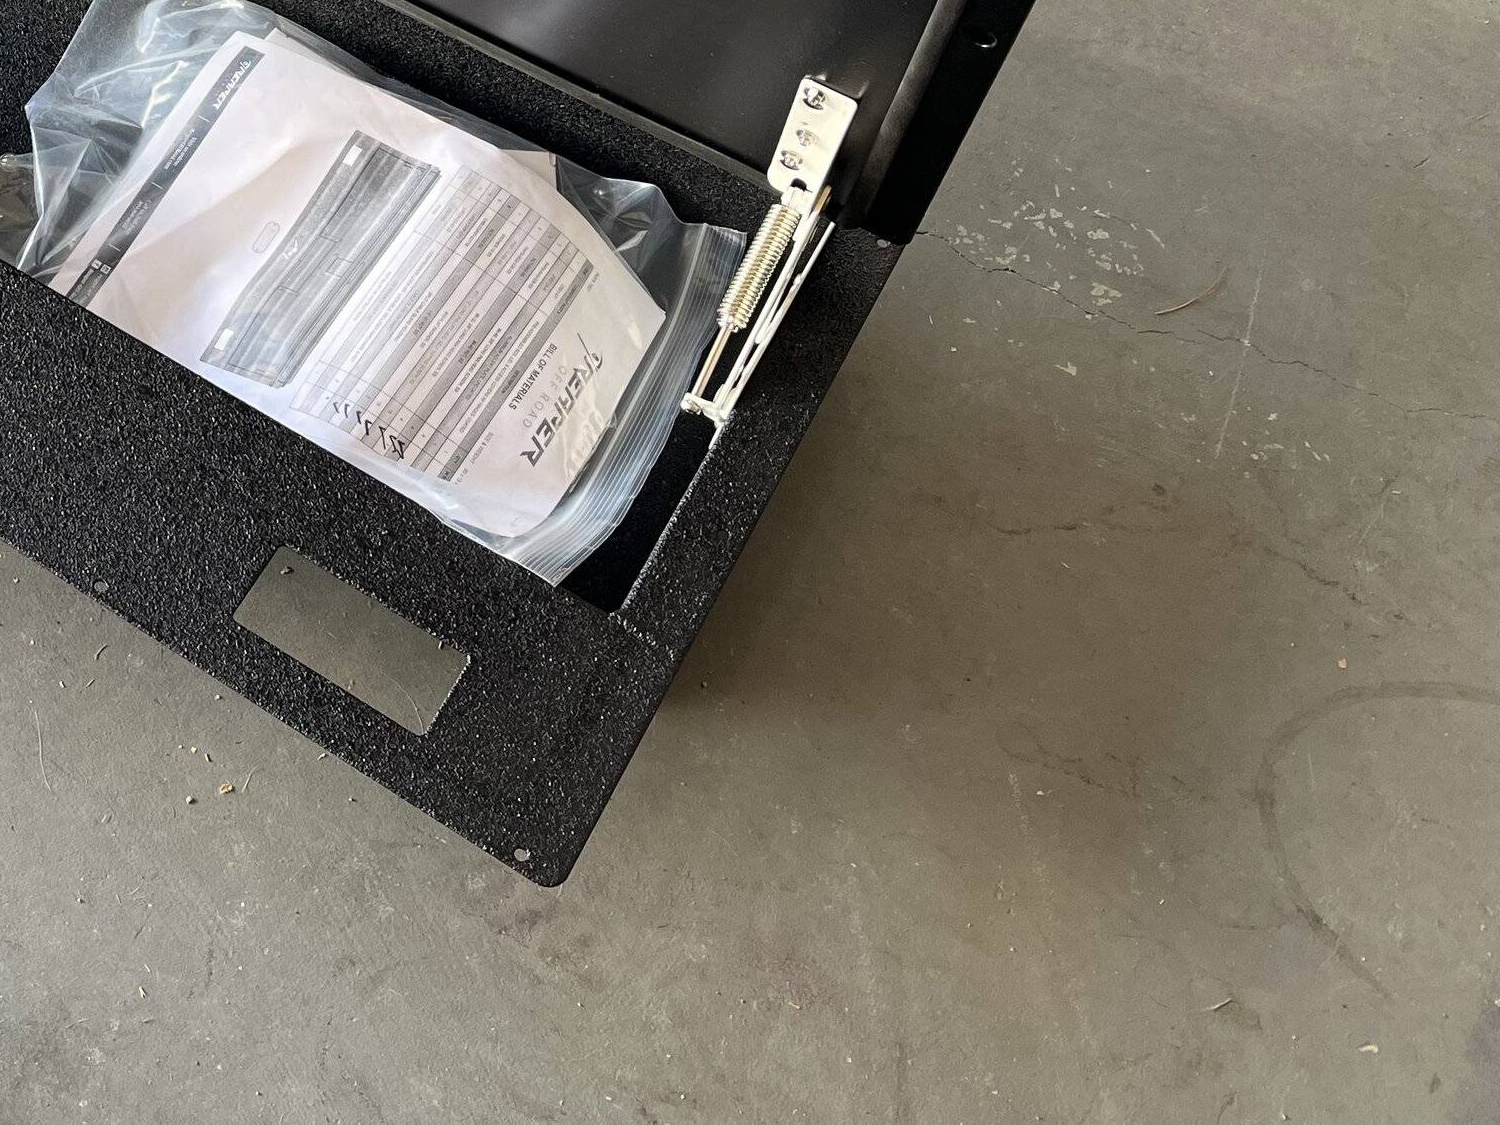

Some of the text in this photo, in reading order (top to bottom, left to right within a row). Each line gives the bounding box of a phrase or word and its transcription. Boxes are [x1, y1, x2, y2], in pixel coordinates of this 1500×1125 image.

[534, 357, 548, 371] OF
[540, 341, 558, 361] BILL
[507, 368, 541, 411] MATERIALS
[518, 354, 596, 468] REAPER
[519, 362, 569, 430] OFF ROAD
